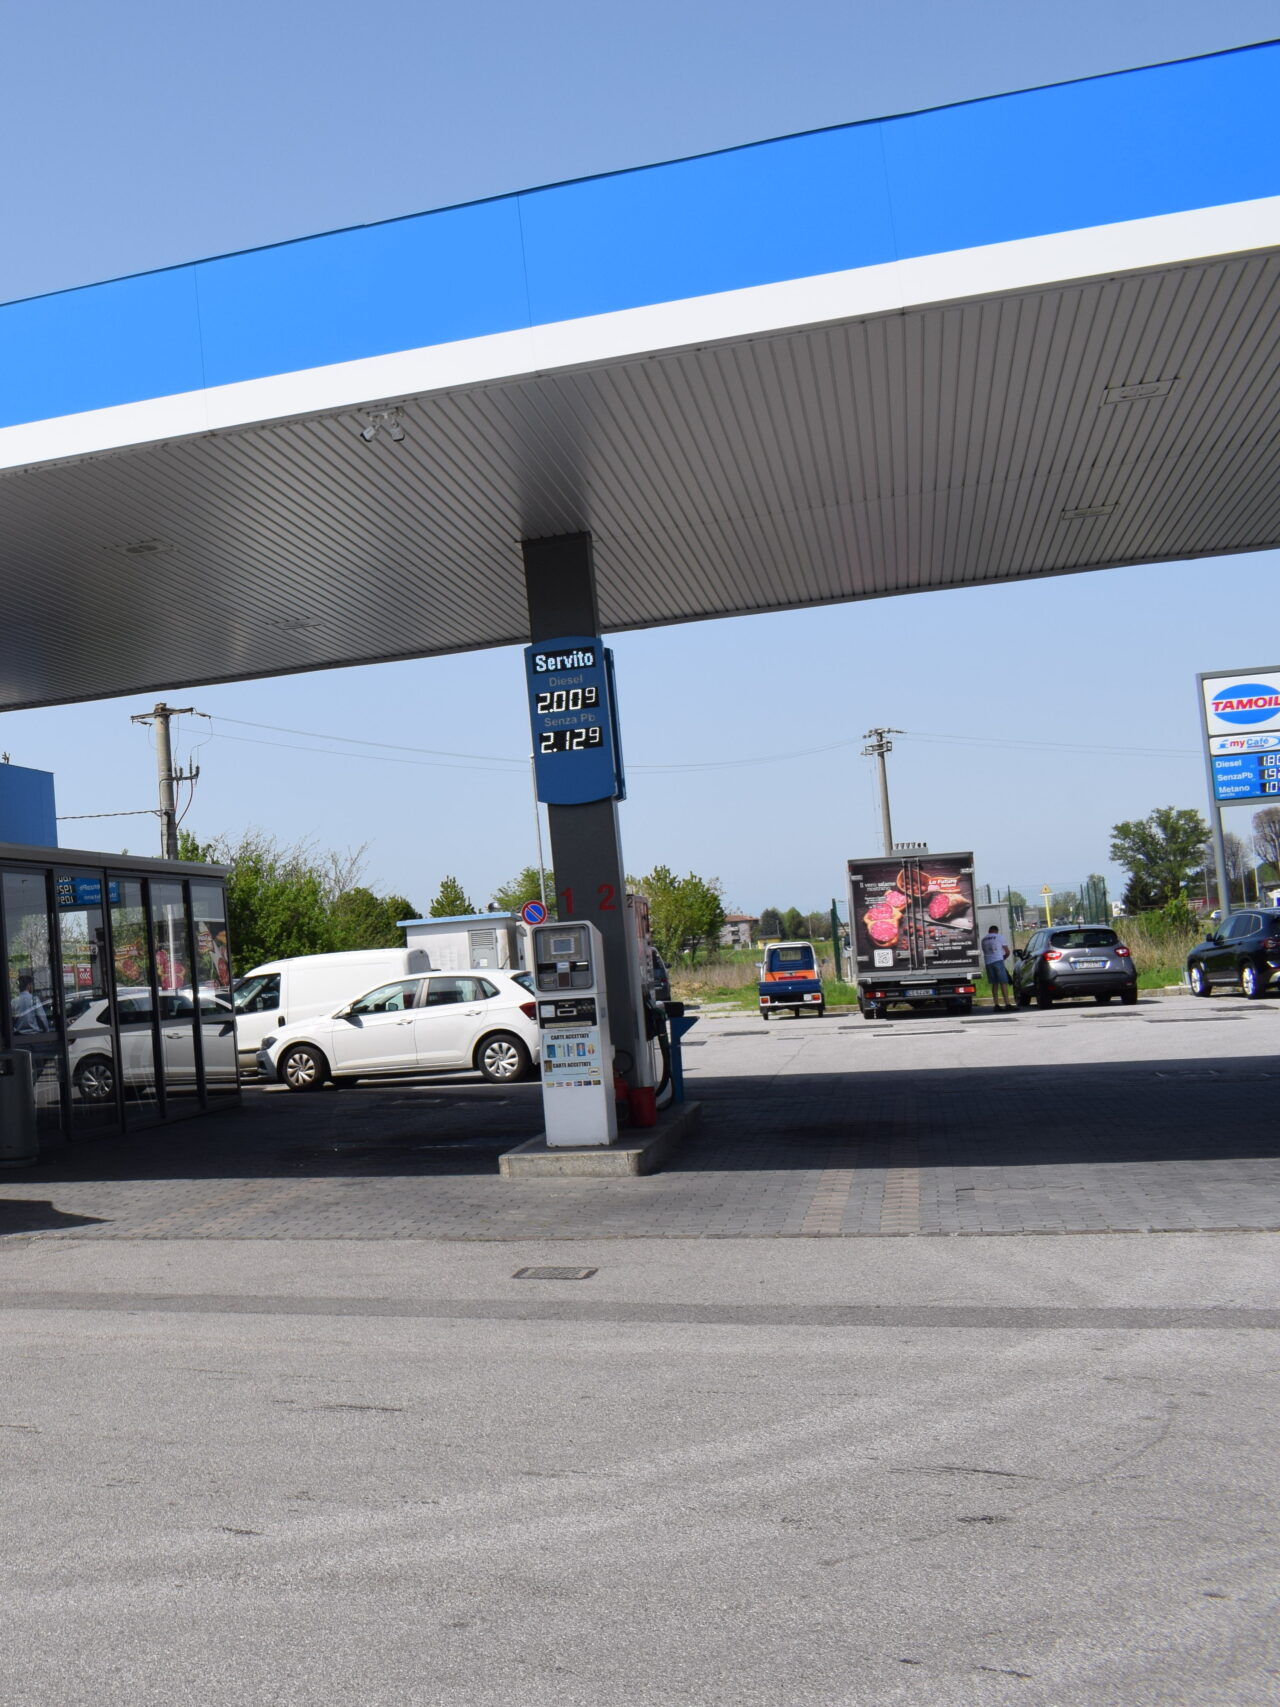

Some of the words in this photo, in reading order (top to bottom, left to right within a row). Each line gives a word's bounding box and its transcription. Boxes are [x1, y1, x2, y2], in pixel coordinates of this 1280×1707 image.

[535, 651, 594, 672] Servito
[549, 674, 583, 687] Diesel
[1212, 696, 1280, 712] TAMOIL
[544, 716, 577, 727] Senza
[580, 713, 595, 722] Pb
[1215, 759, 1242, 768] Diesel
[1219, 785, 1250, 793] Metano
[561, 888, 574, 913] 1
[597, 884, 617, 911] 2
[627, 896, 633, 908] 2
